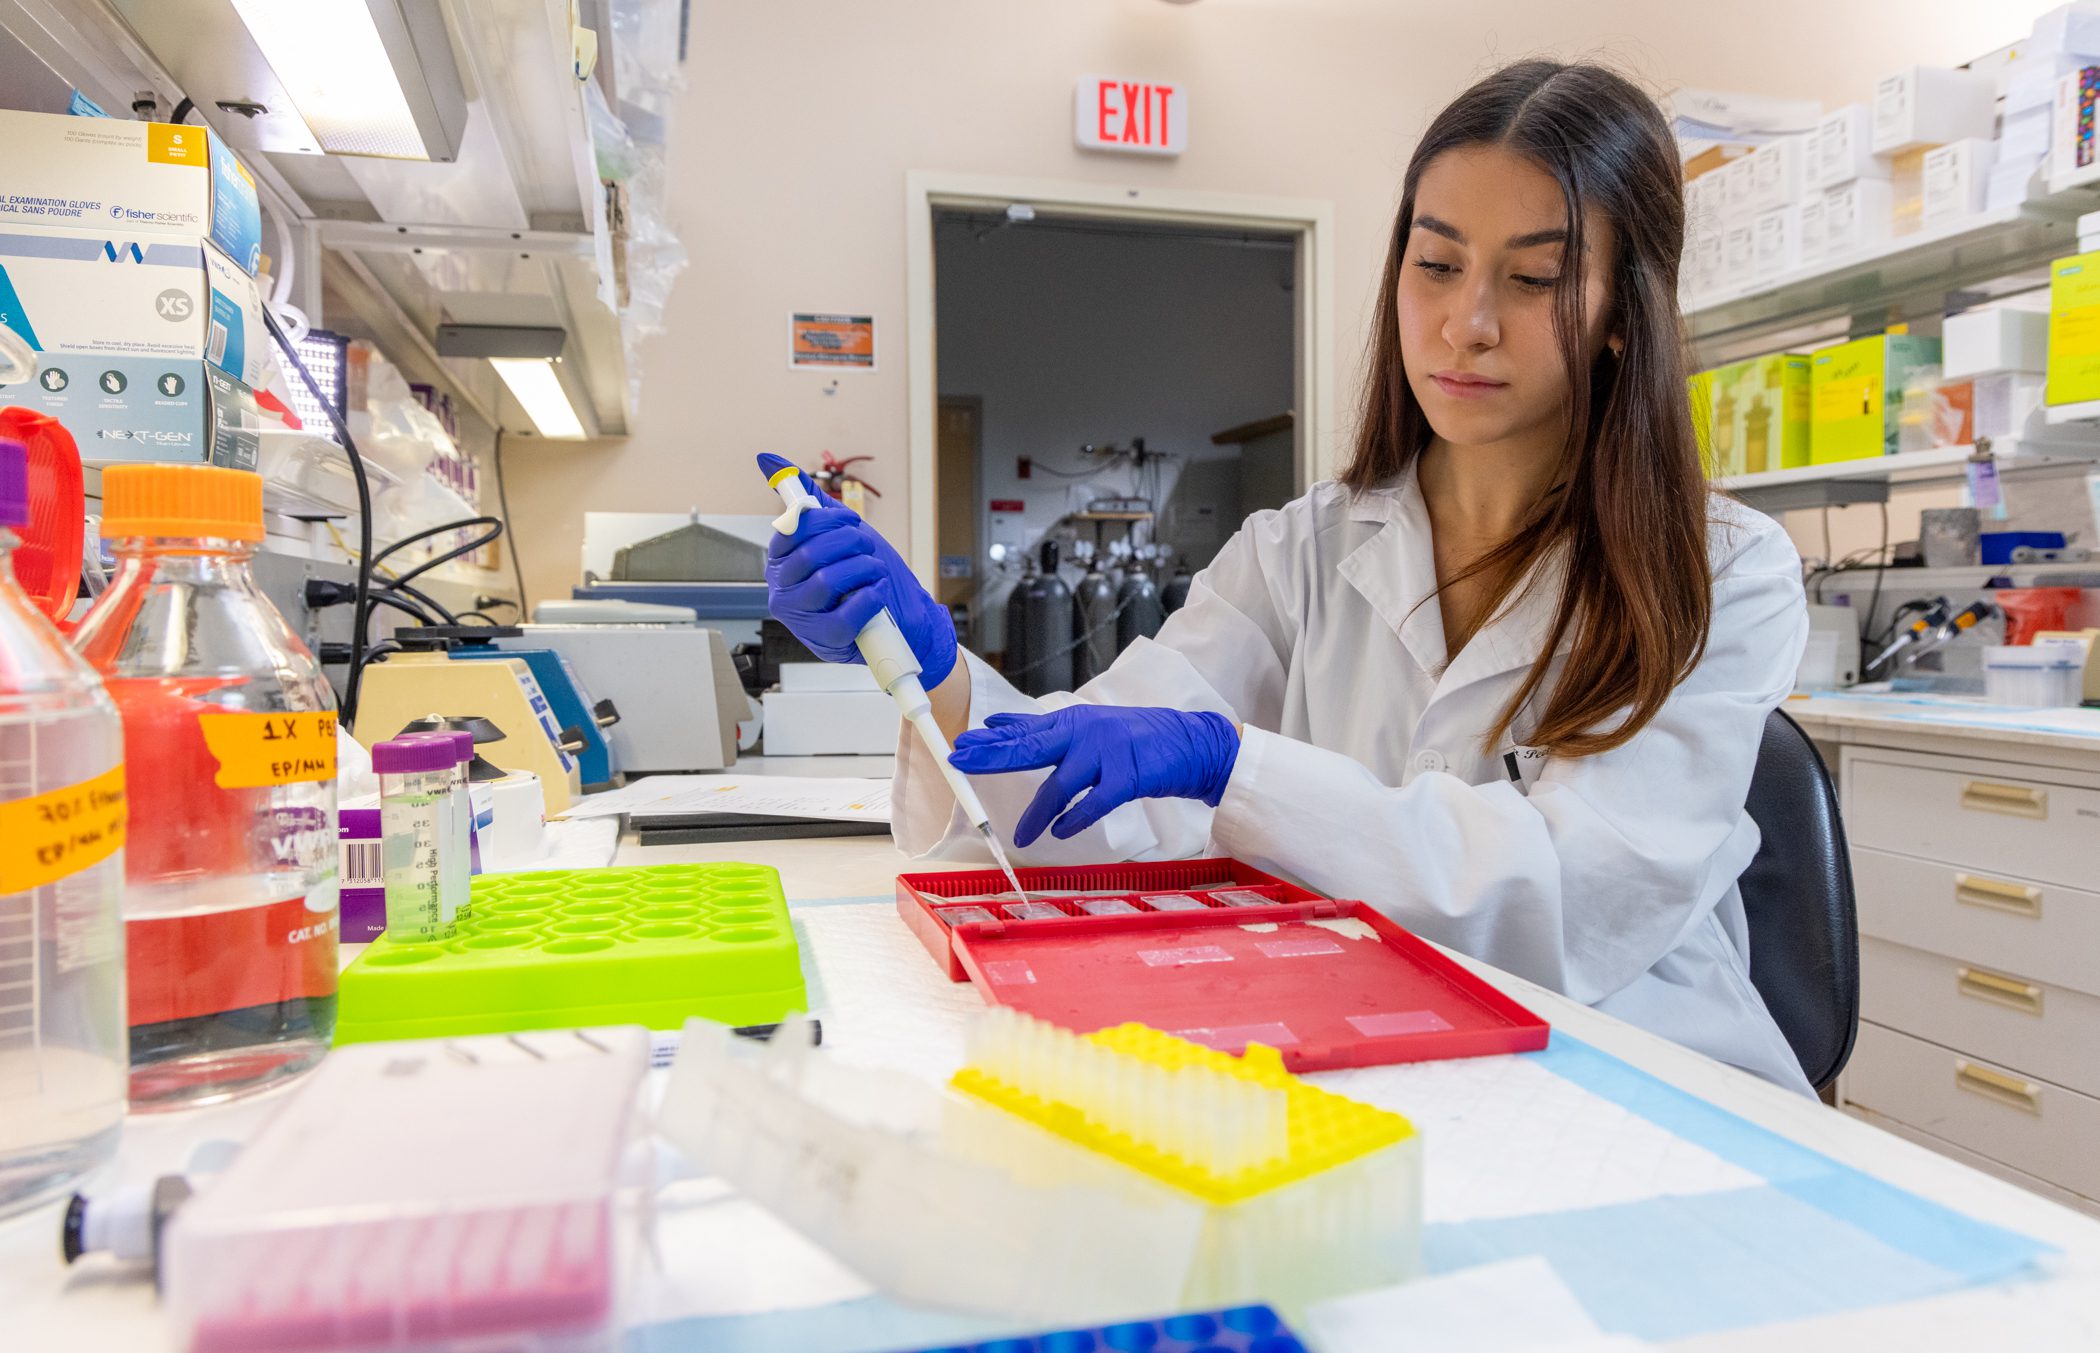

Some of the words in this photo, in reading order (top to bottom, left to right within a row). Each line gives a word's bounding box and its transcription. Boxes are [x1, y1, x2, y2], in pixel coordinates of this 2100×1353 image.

[1098, 81, 1173, 146] EXIT
[173, 134, 183, 145] S
[0, 195, 6, 204] L
[9, 196, 67, 207] EXAMINATION
[69, 201, 101, 210] GLOVES
[22, 206, 45, 215] SANS
[48, 208, 82, 217] POUDRE
[126, 208, 155, 219] fisher
[156, 212, 198, 223] scientific
[160, 297, 188, 317] XS
[271, 758, 325, 777] EP/MM
[430, 848, 438, 868] High
[430, 870, 438, 922] Performance
